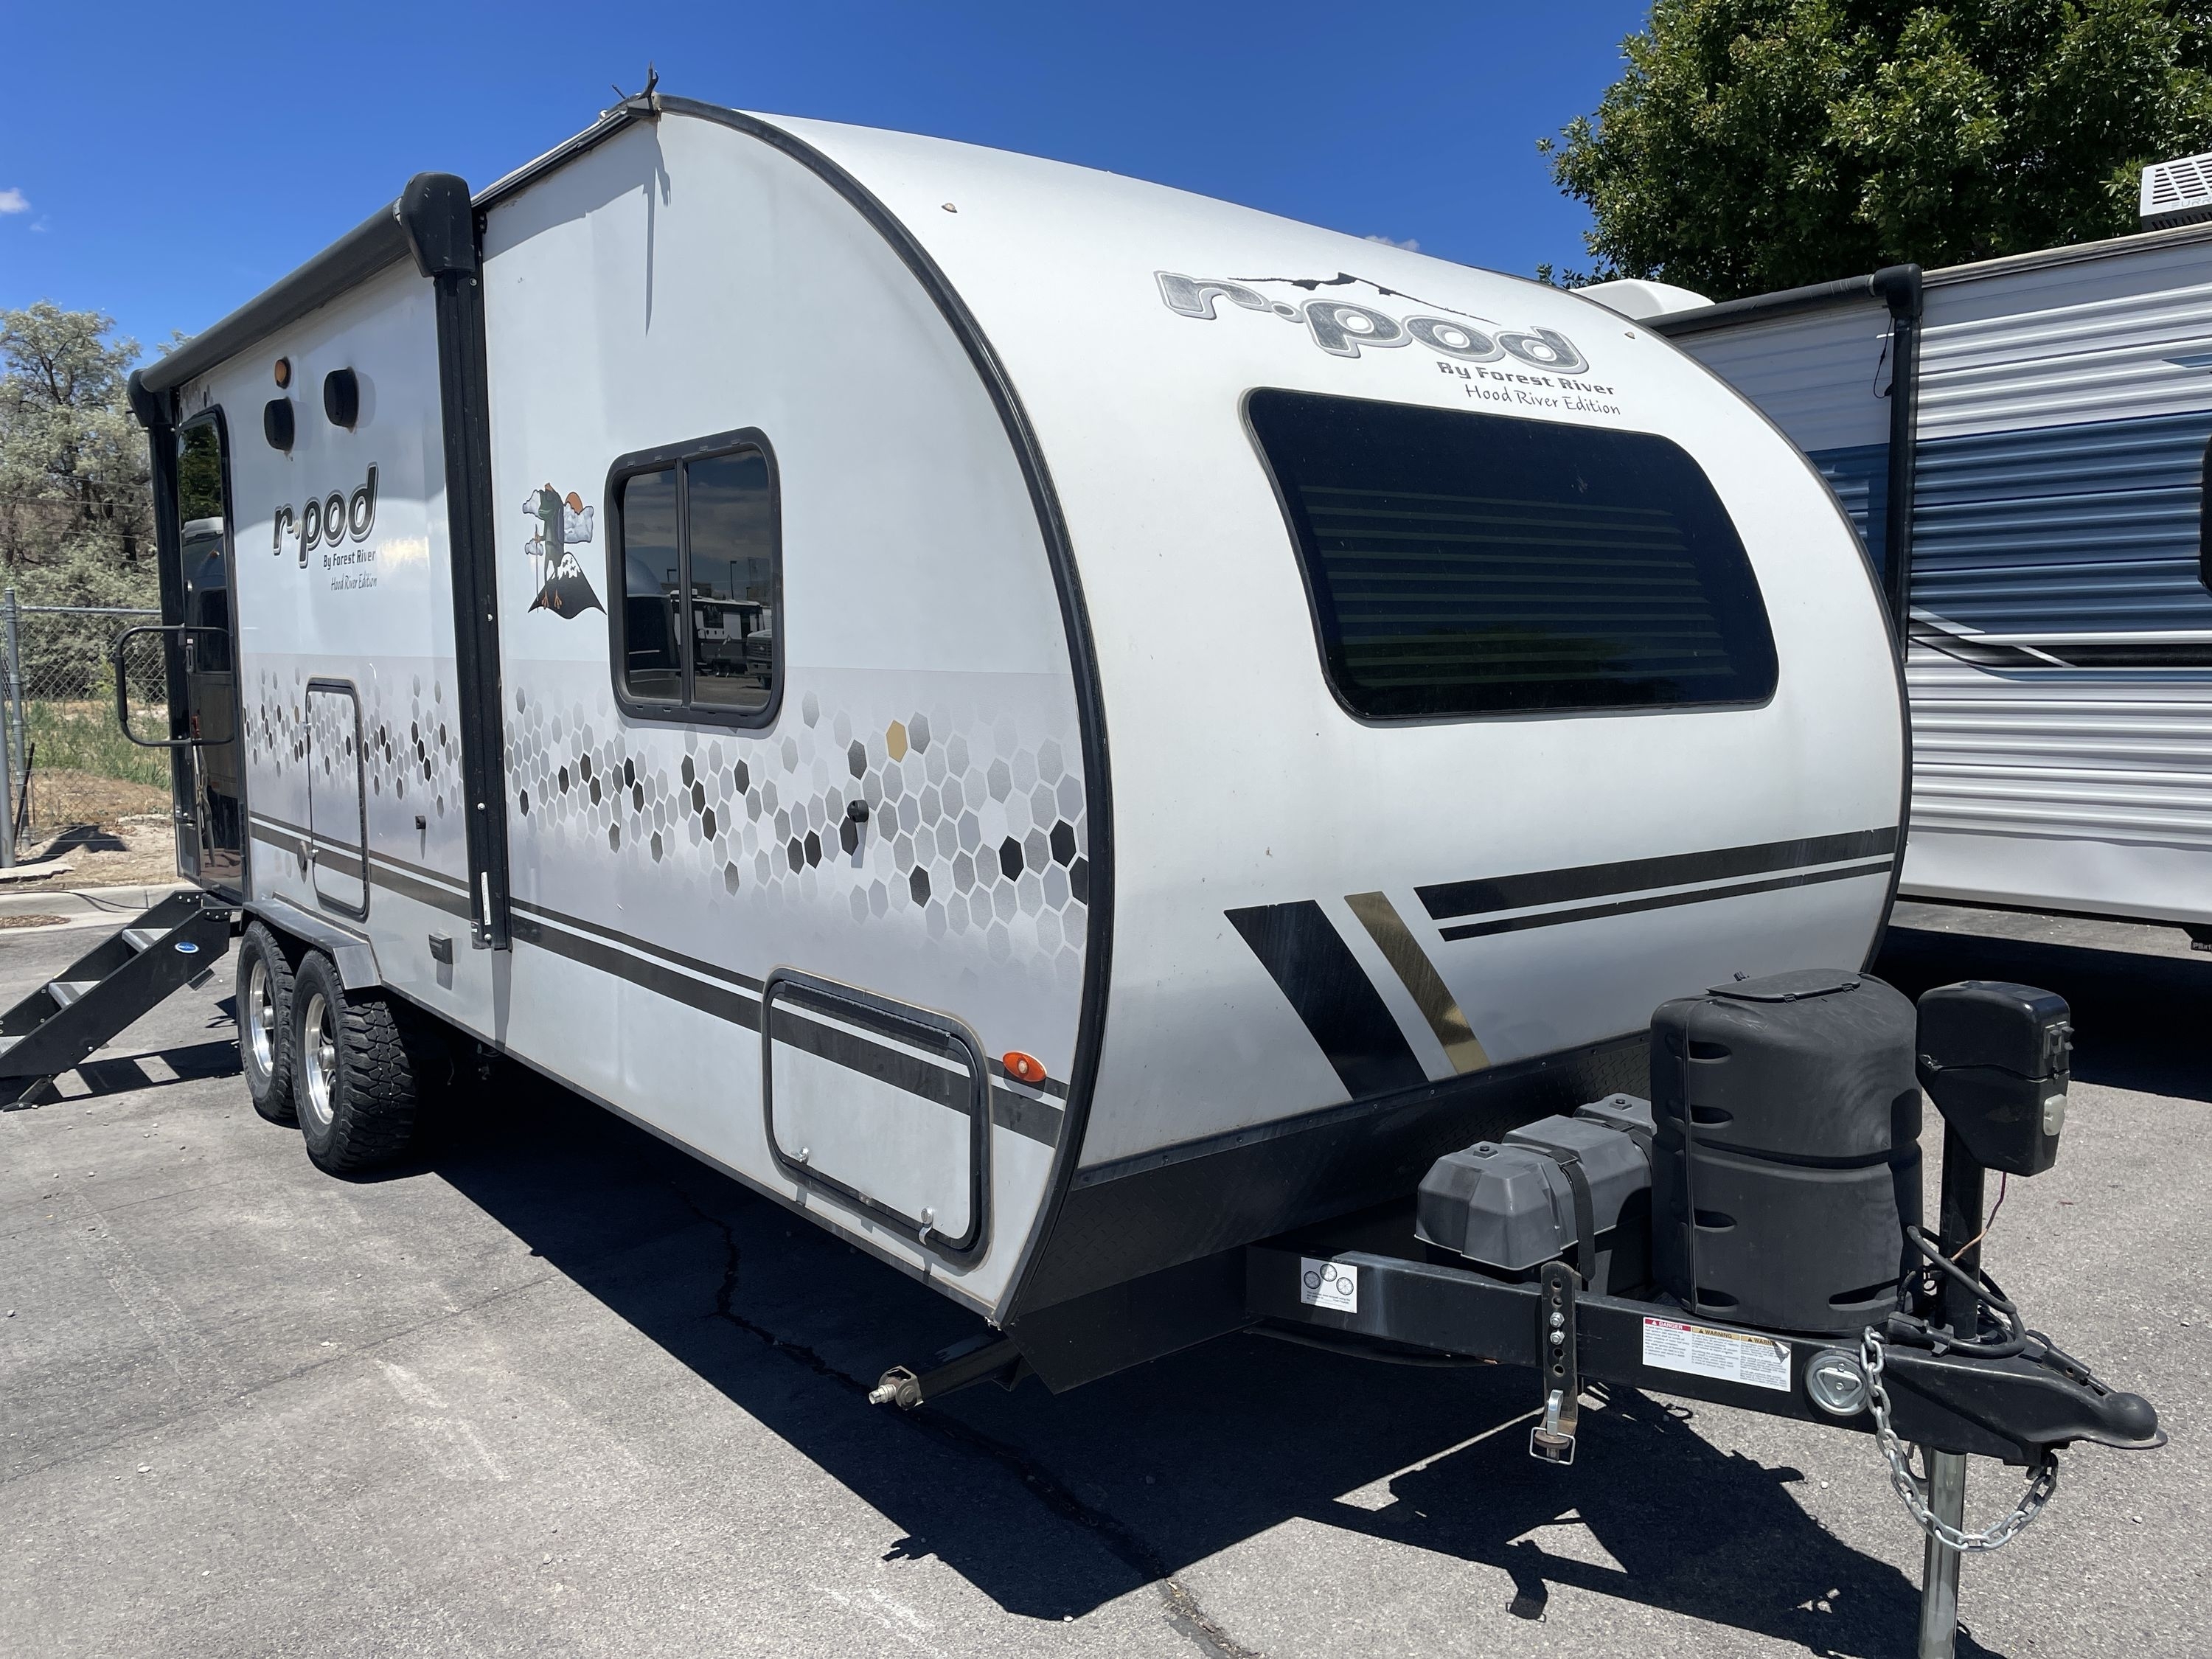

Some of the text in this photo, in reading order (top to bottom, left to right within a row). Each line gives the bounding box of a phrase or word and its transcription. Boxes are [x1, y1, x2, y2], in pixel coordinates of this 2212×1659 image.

[1436, 361, 1614, 394] By Forest River
[1465, 384, 1621, 415] Hood River Edition
[324, 549, 376, 570] By Forest River
[1658, 1321, 1683, 1330] DANGER
[1704, 1329, 1732, 1339] WARNING
